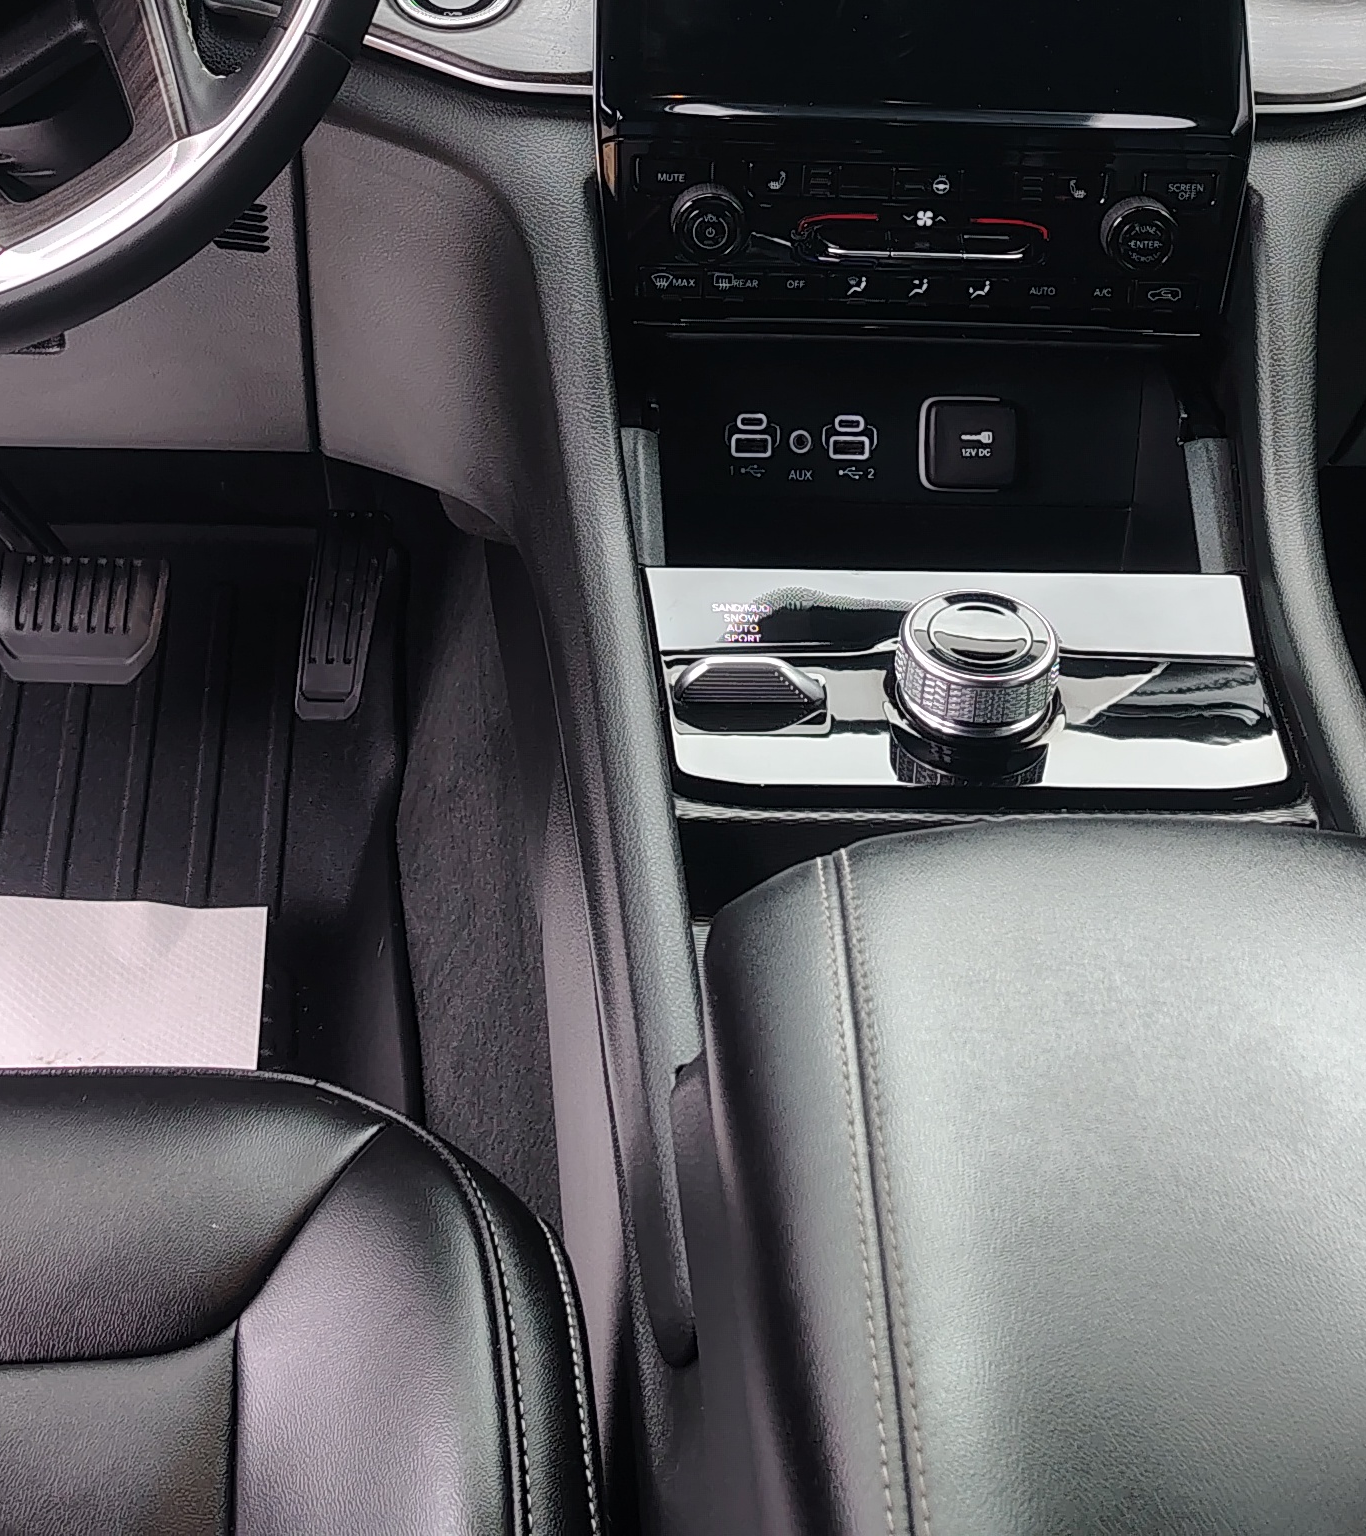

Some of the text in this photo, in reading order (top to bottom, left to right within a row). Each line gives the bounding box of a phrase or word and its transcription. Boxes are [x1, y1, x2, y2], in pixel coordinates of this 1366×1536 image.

[657, 173, 685, 183] MUTE
[1167, 183, 1204, 193] SCREEN
[1178, 192, 1197, 201] OFF
[703, 215, 719, 224] VOL
[1135, 225, 1156, 235] TUNE
[1131, 240, 1160, 249] ENTER
[1129, 251, 1161, 263] SCROLL
[672, 278, 695, 288] MAX
[733, 279, 758, 288] REAR
[787, 280, 806, 289] OFF
[1030, 287, 1055, 296] AUTO
[1093, 289, 1112, 297] A/C
[961, 448, 991, 457] 12V DC
[729, 466, 735, 476] 1
[788, 469, 814, 481] AUX
[867, 469, 875, 479] 2
[711, 603, 771, 612] SAND/MUD
[723, 613, 760, 622] SNOW
[726, 624, 759, 632] AUTO
[724, 634, 762, 642] SPORT
